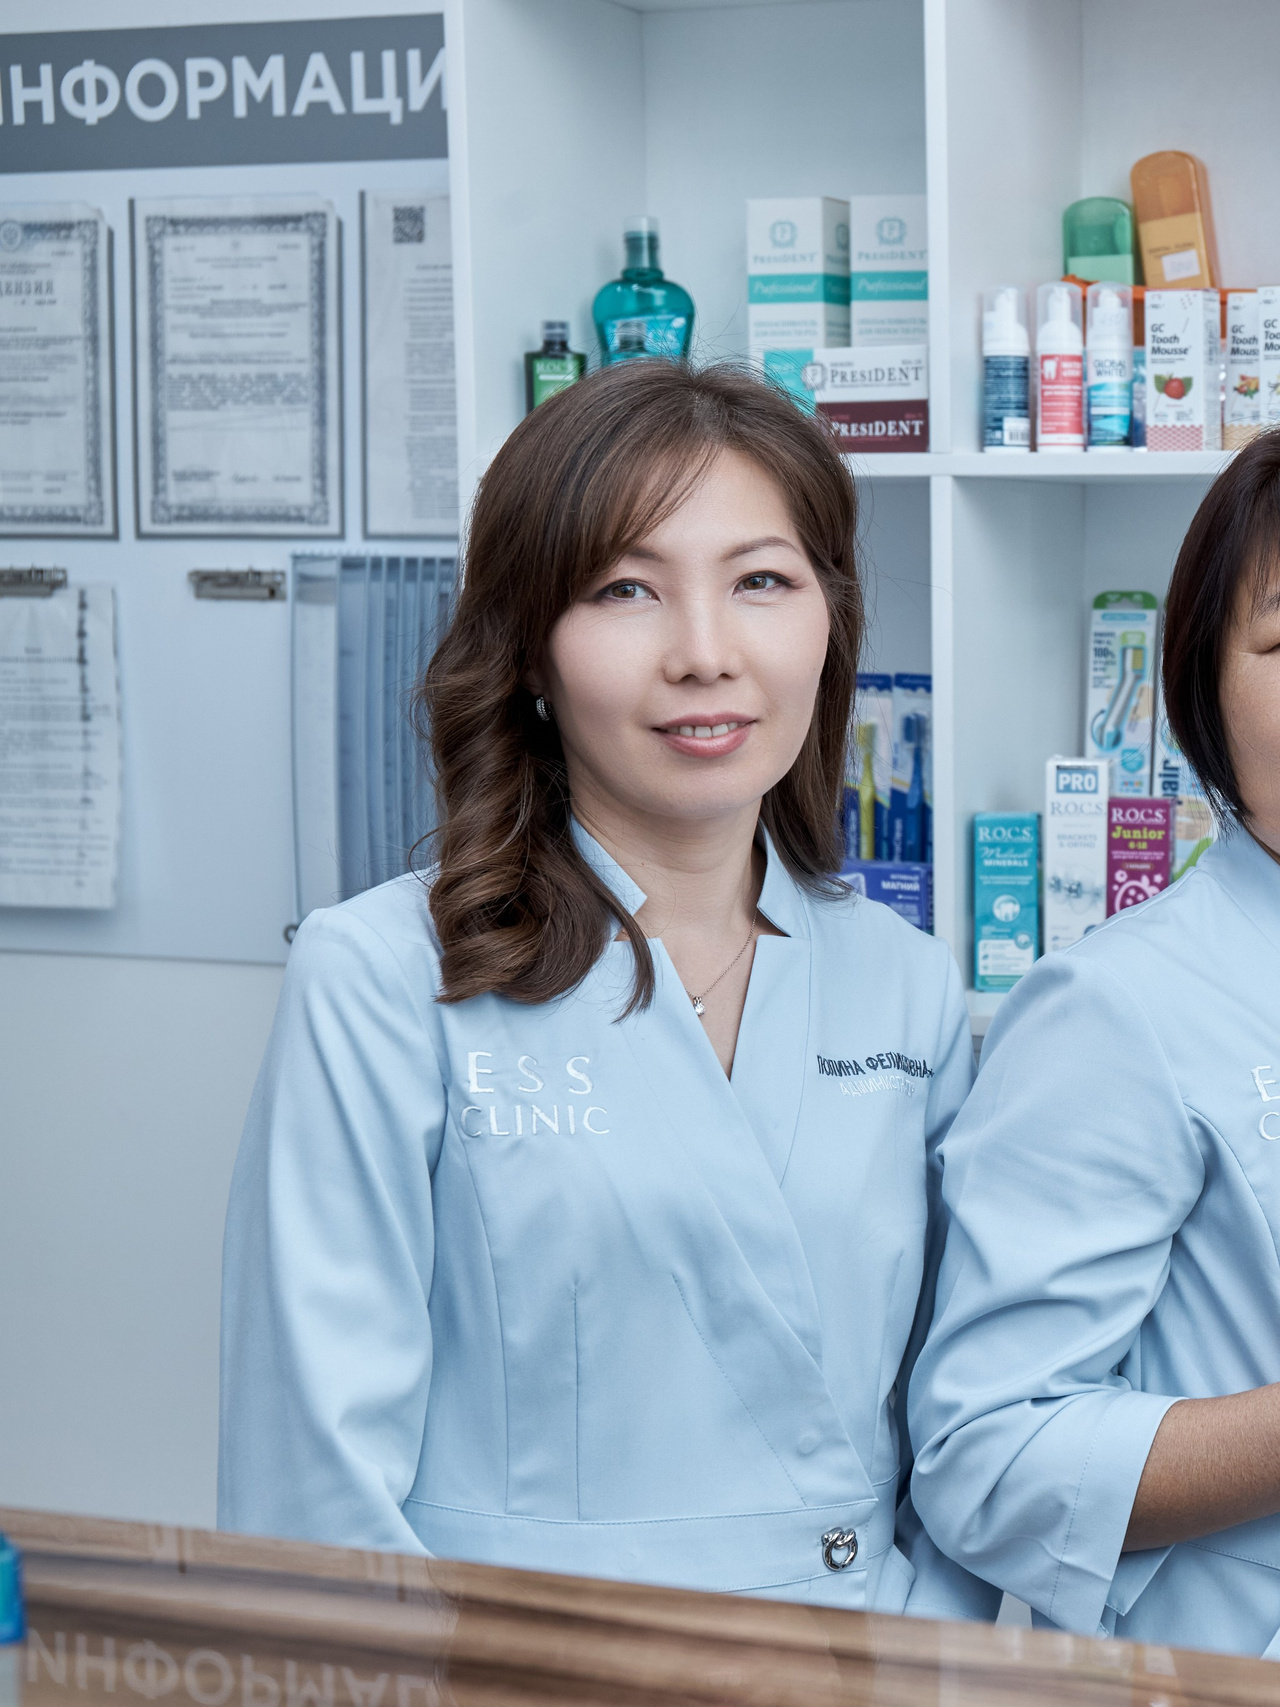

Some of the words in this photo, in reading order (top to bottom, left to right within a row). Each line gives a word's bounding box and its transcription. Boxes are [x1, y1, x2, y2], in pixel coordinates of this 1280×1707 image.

[0, 48, 449, 126] НФОРМАЦИ
[1151, 324, 1165, 333] GC
[1263, 319, 1278, 329] GC
[1231, 325, 1245, 334] GC
[1151, 335, 1180, 344] Tooth
[1231, 336, 1259, 345] Tooth
[1151, 347, 1189, 355] Mousse
[1094, 359, 1126, 368] GLOBAL
[1096, 368, 1126, 377] WHITE
[1058, 773, 1096, 792] PRO
[1111, 826, 1165, 840] Junior
[817, 1055, 866, 1077] ПОЛИНА
[460, 1105, 610, 1138] CLINIC
